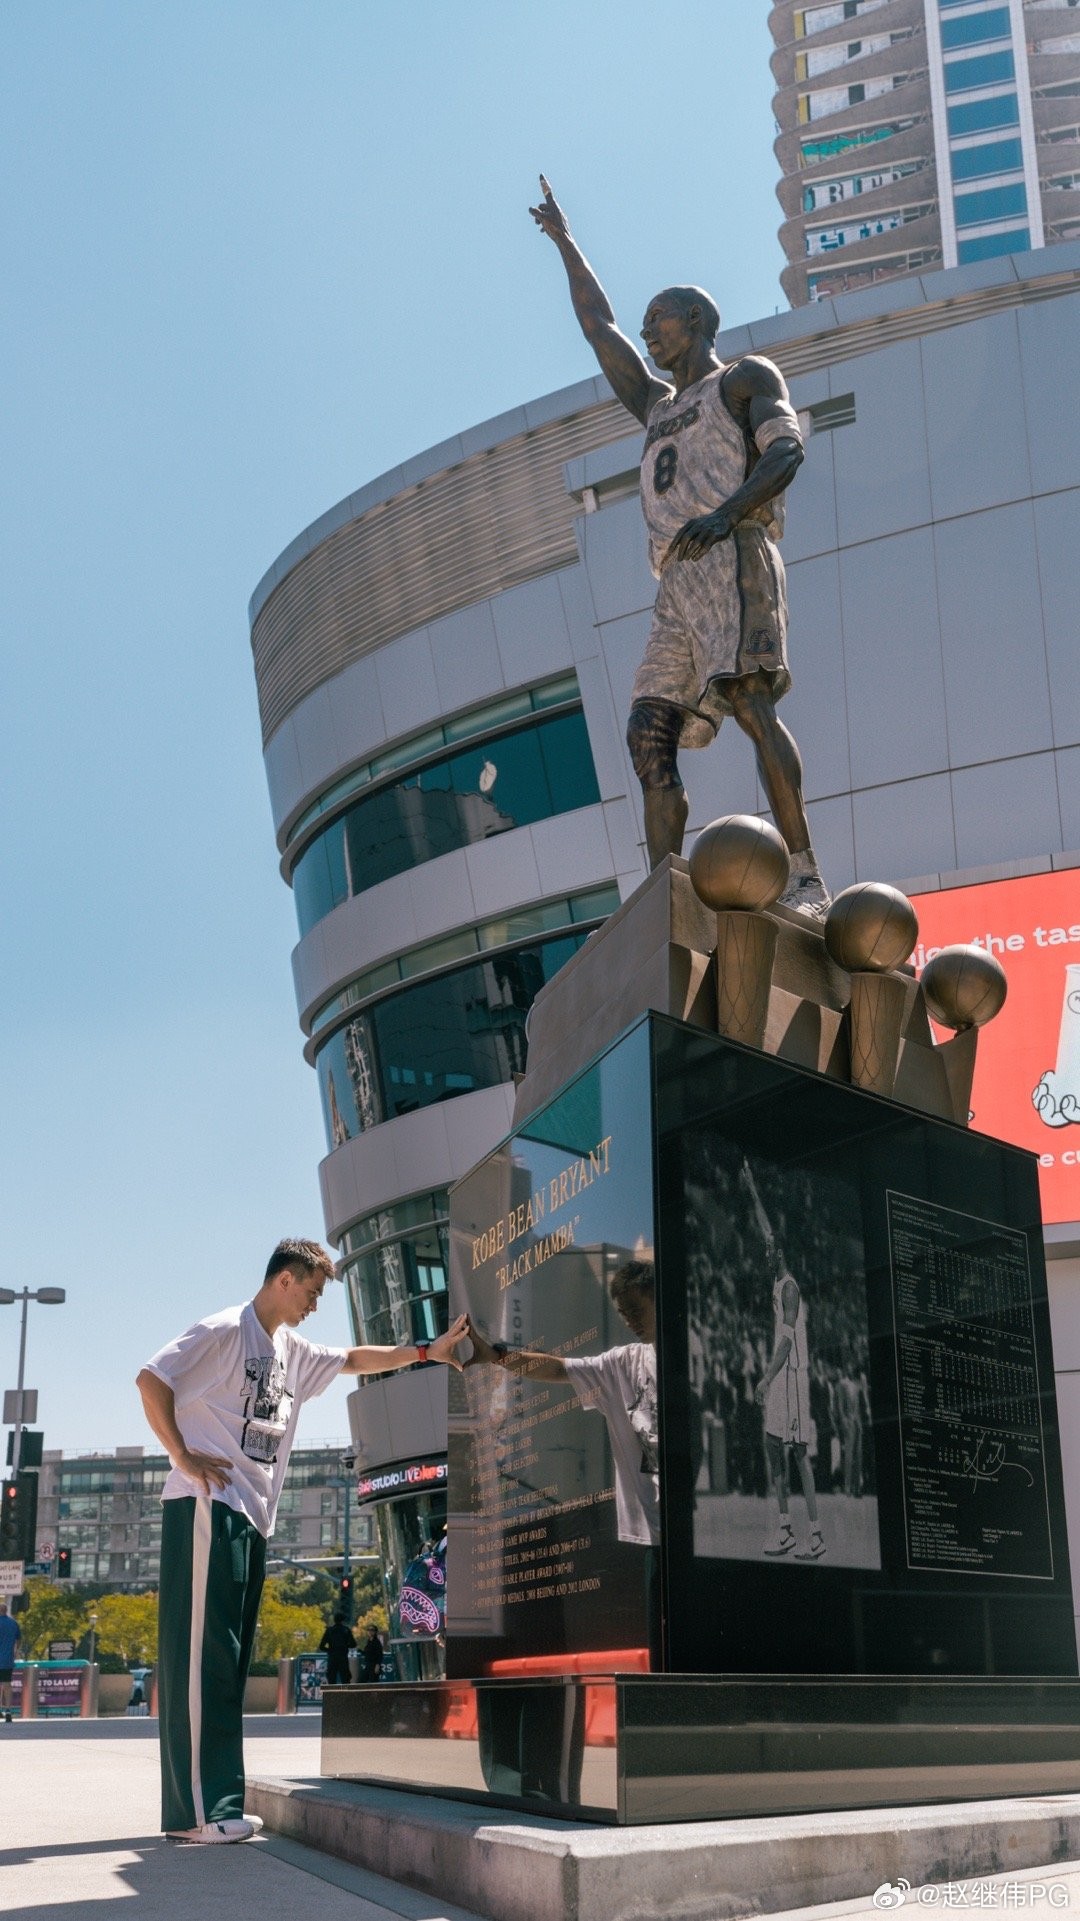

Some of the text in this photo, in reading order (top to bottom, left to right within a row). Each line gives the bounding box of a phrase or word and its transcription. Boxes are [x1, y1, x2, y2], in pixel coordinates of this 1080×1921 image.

[654, 447, 677, 495] 8
[472, 1136, 612, 1270] KOBE BEAN BRYANT
[371, 1472, 399, 1491] STUDIO
